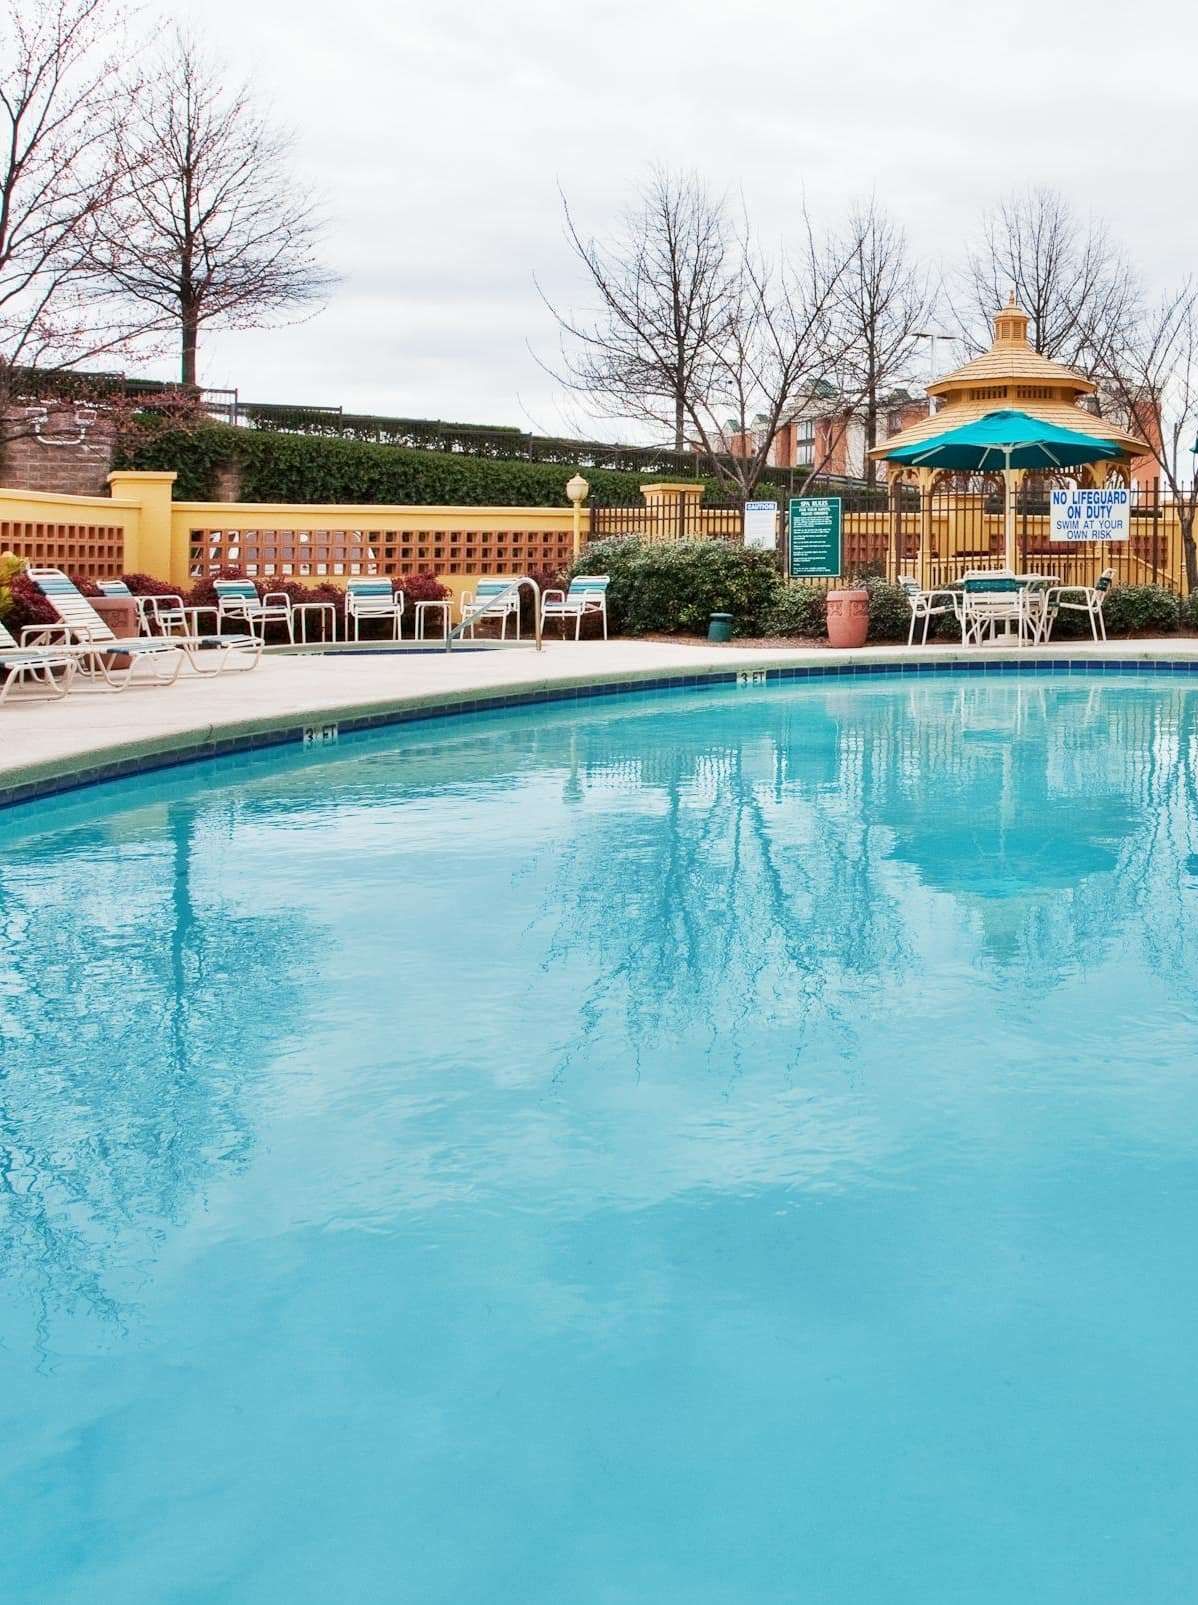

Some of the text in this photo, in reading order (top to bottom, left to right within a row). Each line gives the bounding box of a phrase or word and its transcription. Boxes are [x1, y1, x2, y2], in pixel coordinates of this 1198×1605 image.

[1053, 491, 1127, 504] NO LIFEGUARD
[1067, 505, 1112, 519] ON DUTY
[1056, 520, 1123, 529] SWIM AT YOUR
[1067, 530, 1112, 539] OWN RISK
